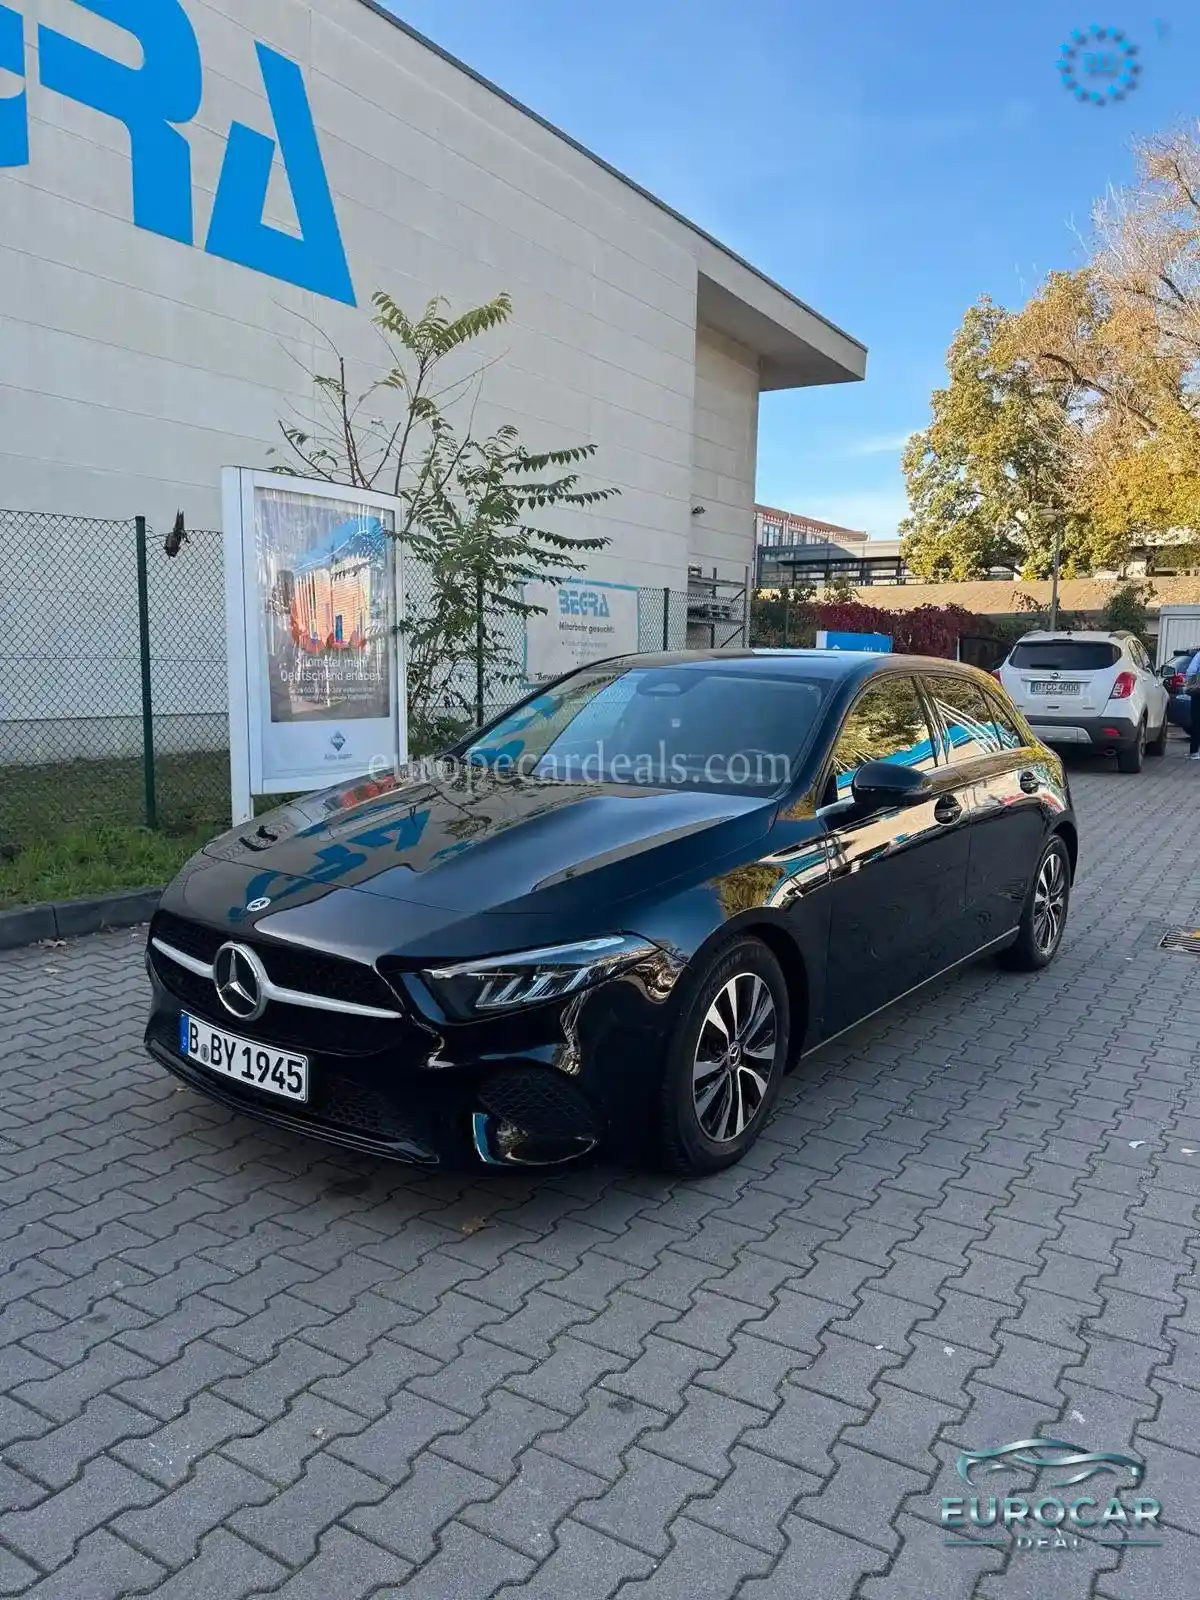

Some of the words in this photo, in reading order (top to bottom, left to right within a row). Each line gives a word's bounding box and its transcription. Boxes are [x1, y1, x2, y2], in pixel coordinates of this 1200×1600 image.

[280, 669, 343, 682] Deutschland
[189, 1022, 199, 1054] B
[211, 1033, 237, 1071] BY
[241, 1047, 303, 1094] 1945
